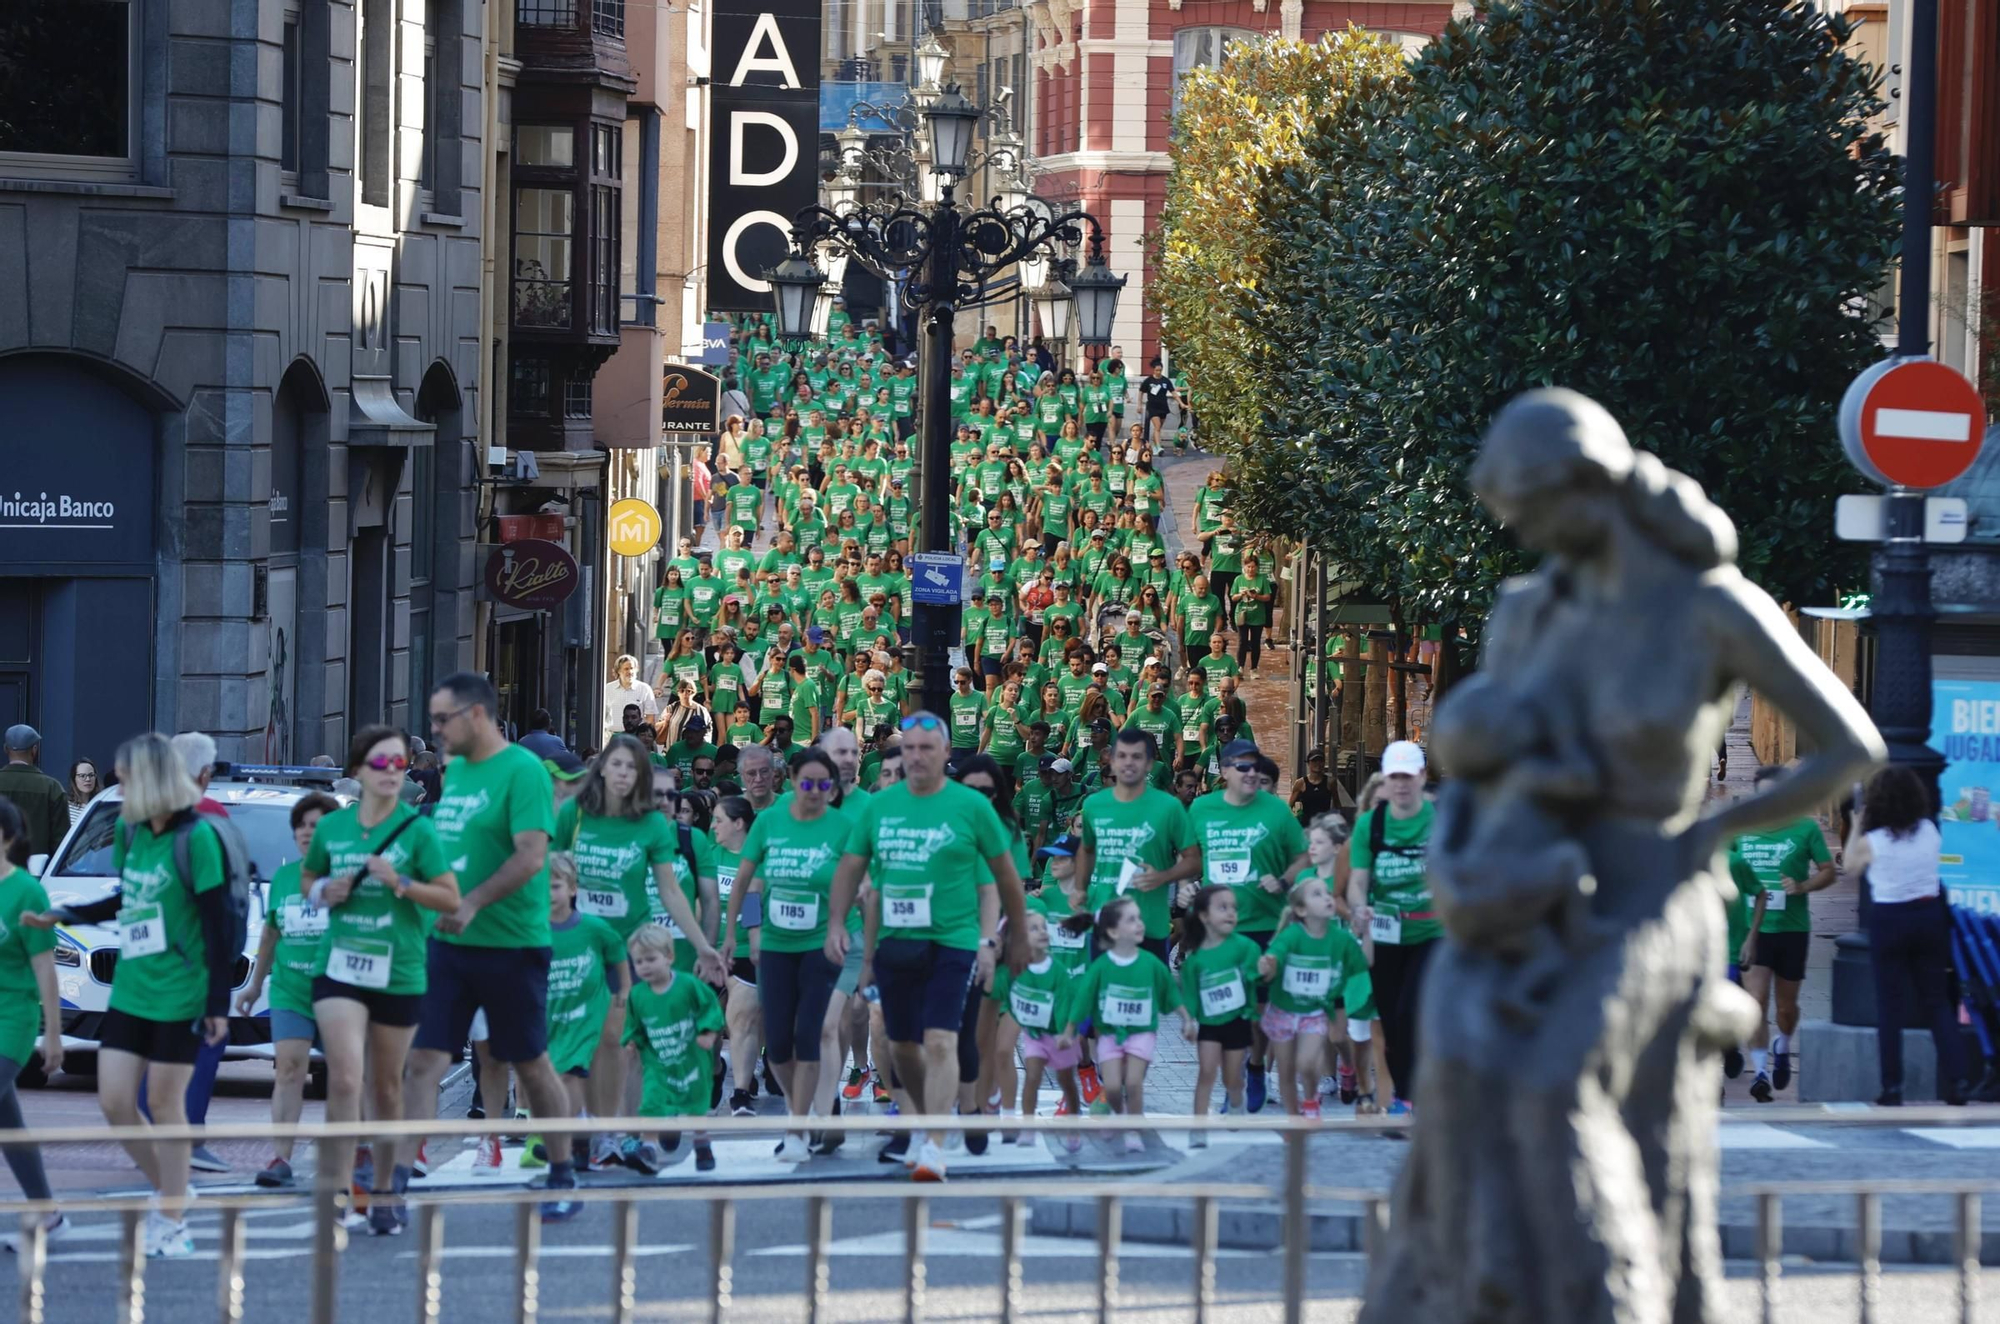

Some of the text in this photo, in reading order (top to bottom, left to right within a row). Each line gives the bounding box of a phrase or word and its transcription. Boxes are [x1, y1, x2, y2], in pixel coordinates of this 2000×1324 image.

[0, 491, 114, 523] nicaja Banco
[496, 557, 570, 594] Rialto
[1945, 735, 2000, 763] JUGA
[878, 826, 946, 840] En marcha
[1206, 828, 1260, 838] En marcha
[877, 838, 916, 850] contra
[1208, 838, 1238, 847] contra
[1742, 843, 1753, 851] En
[574, 840, 635, 860] En marcha
[768, 846, 826, 859] En marcha
[889, 850, 931, 862] cáncer
[584, 867, 624, 880] cáncer
[772, 867, 814, 878] cáncer
[1220, 862, 1238, 873] 159
[780, 904, 805, 919] 1185
[346, 954, 374, 972] 1271
[1016, 998, 1039, 1016] 1183
